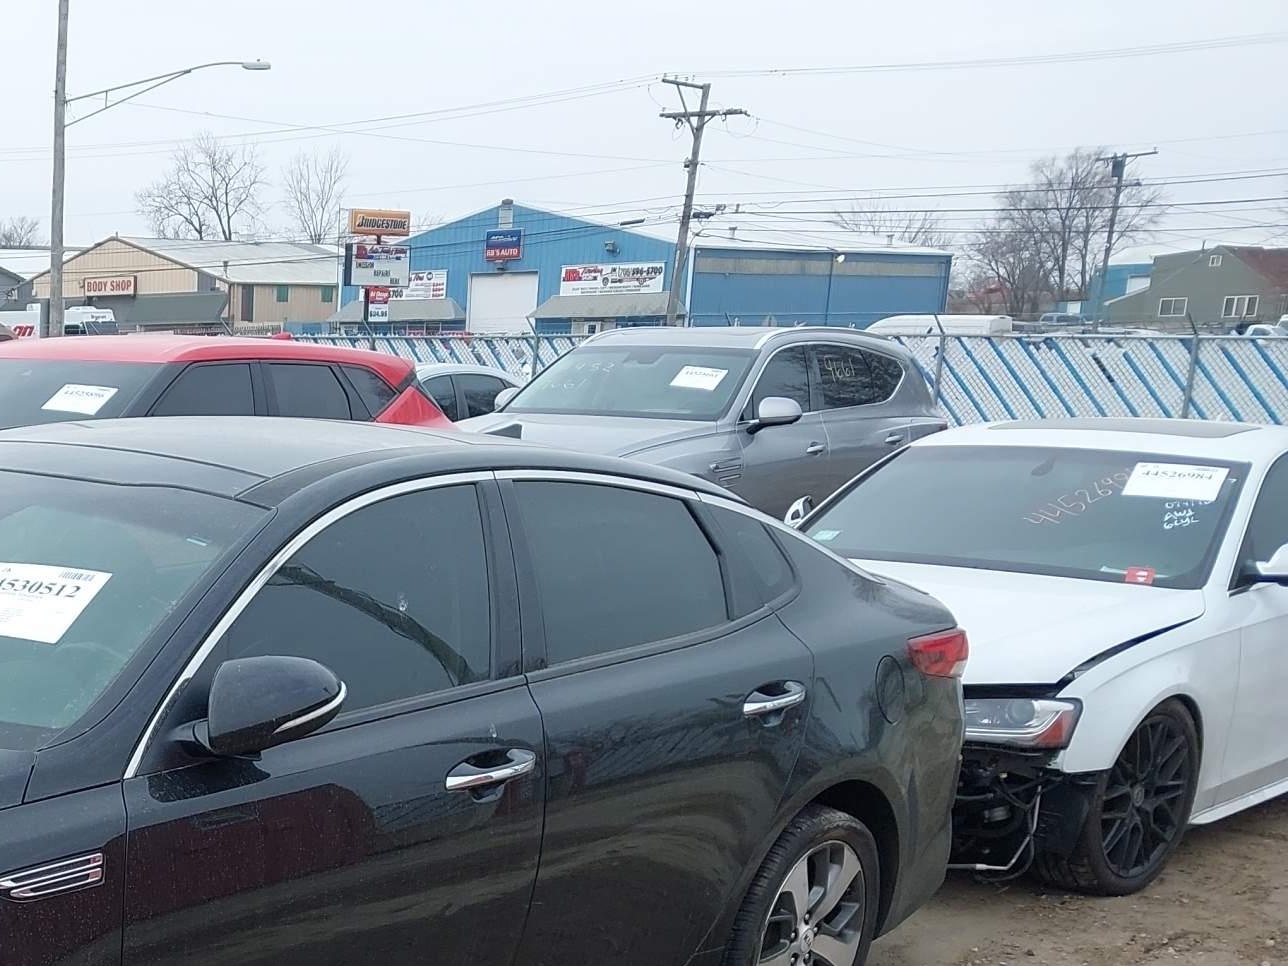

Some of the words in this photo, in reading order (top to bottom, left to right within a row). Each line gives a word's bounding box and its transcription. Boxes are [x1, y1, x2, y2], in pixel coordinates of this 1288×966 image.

[357, 215, 407, 230] BRIDGESTONE
[501, 248, 518, 256] AUTO
[87, 281, 107, 292] BODY
[110, 280, 132, 291] SHOP
[1141, 469, 1214, 482] 44526984
